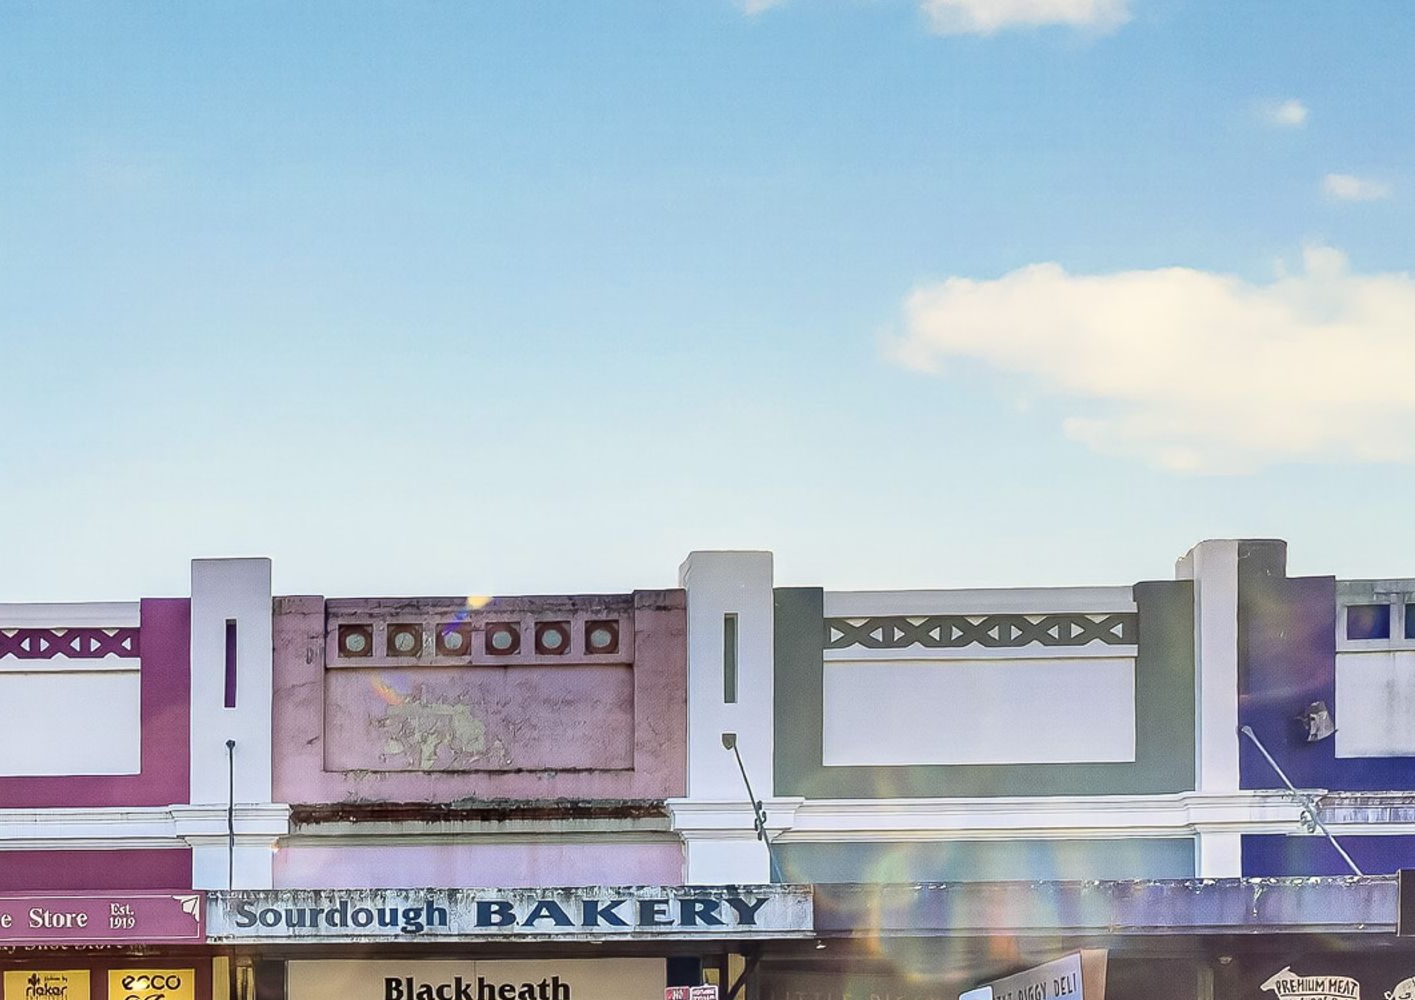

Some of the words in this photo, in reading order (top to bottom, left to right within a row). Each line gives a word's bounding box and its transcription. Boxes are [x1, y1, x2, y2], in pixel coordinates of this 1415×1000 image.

[29, 907, 88, 929] Store
[109, 903, 135, 916] Est.
[235, 901, 448, 934] Sourdough
[473, 898, 770, 927] BAKERY
[109, 917, 136, 930] 1919
[1053, 973, 1077, 997] DELI
[1328, 979, 1358, 995] MEAT
